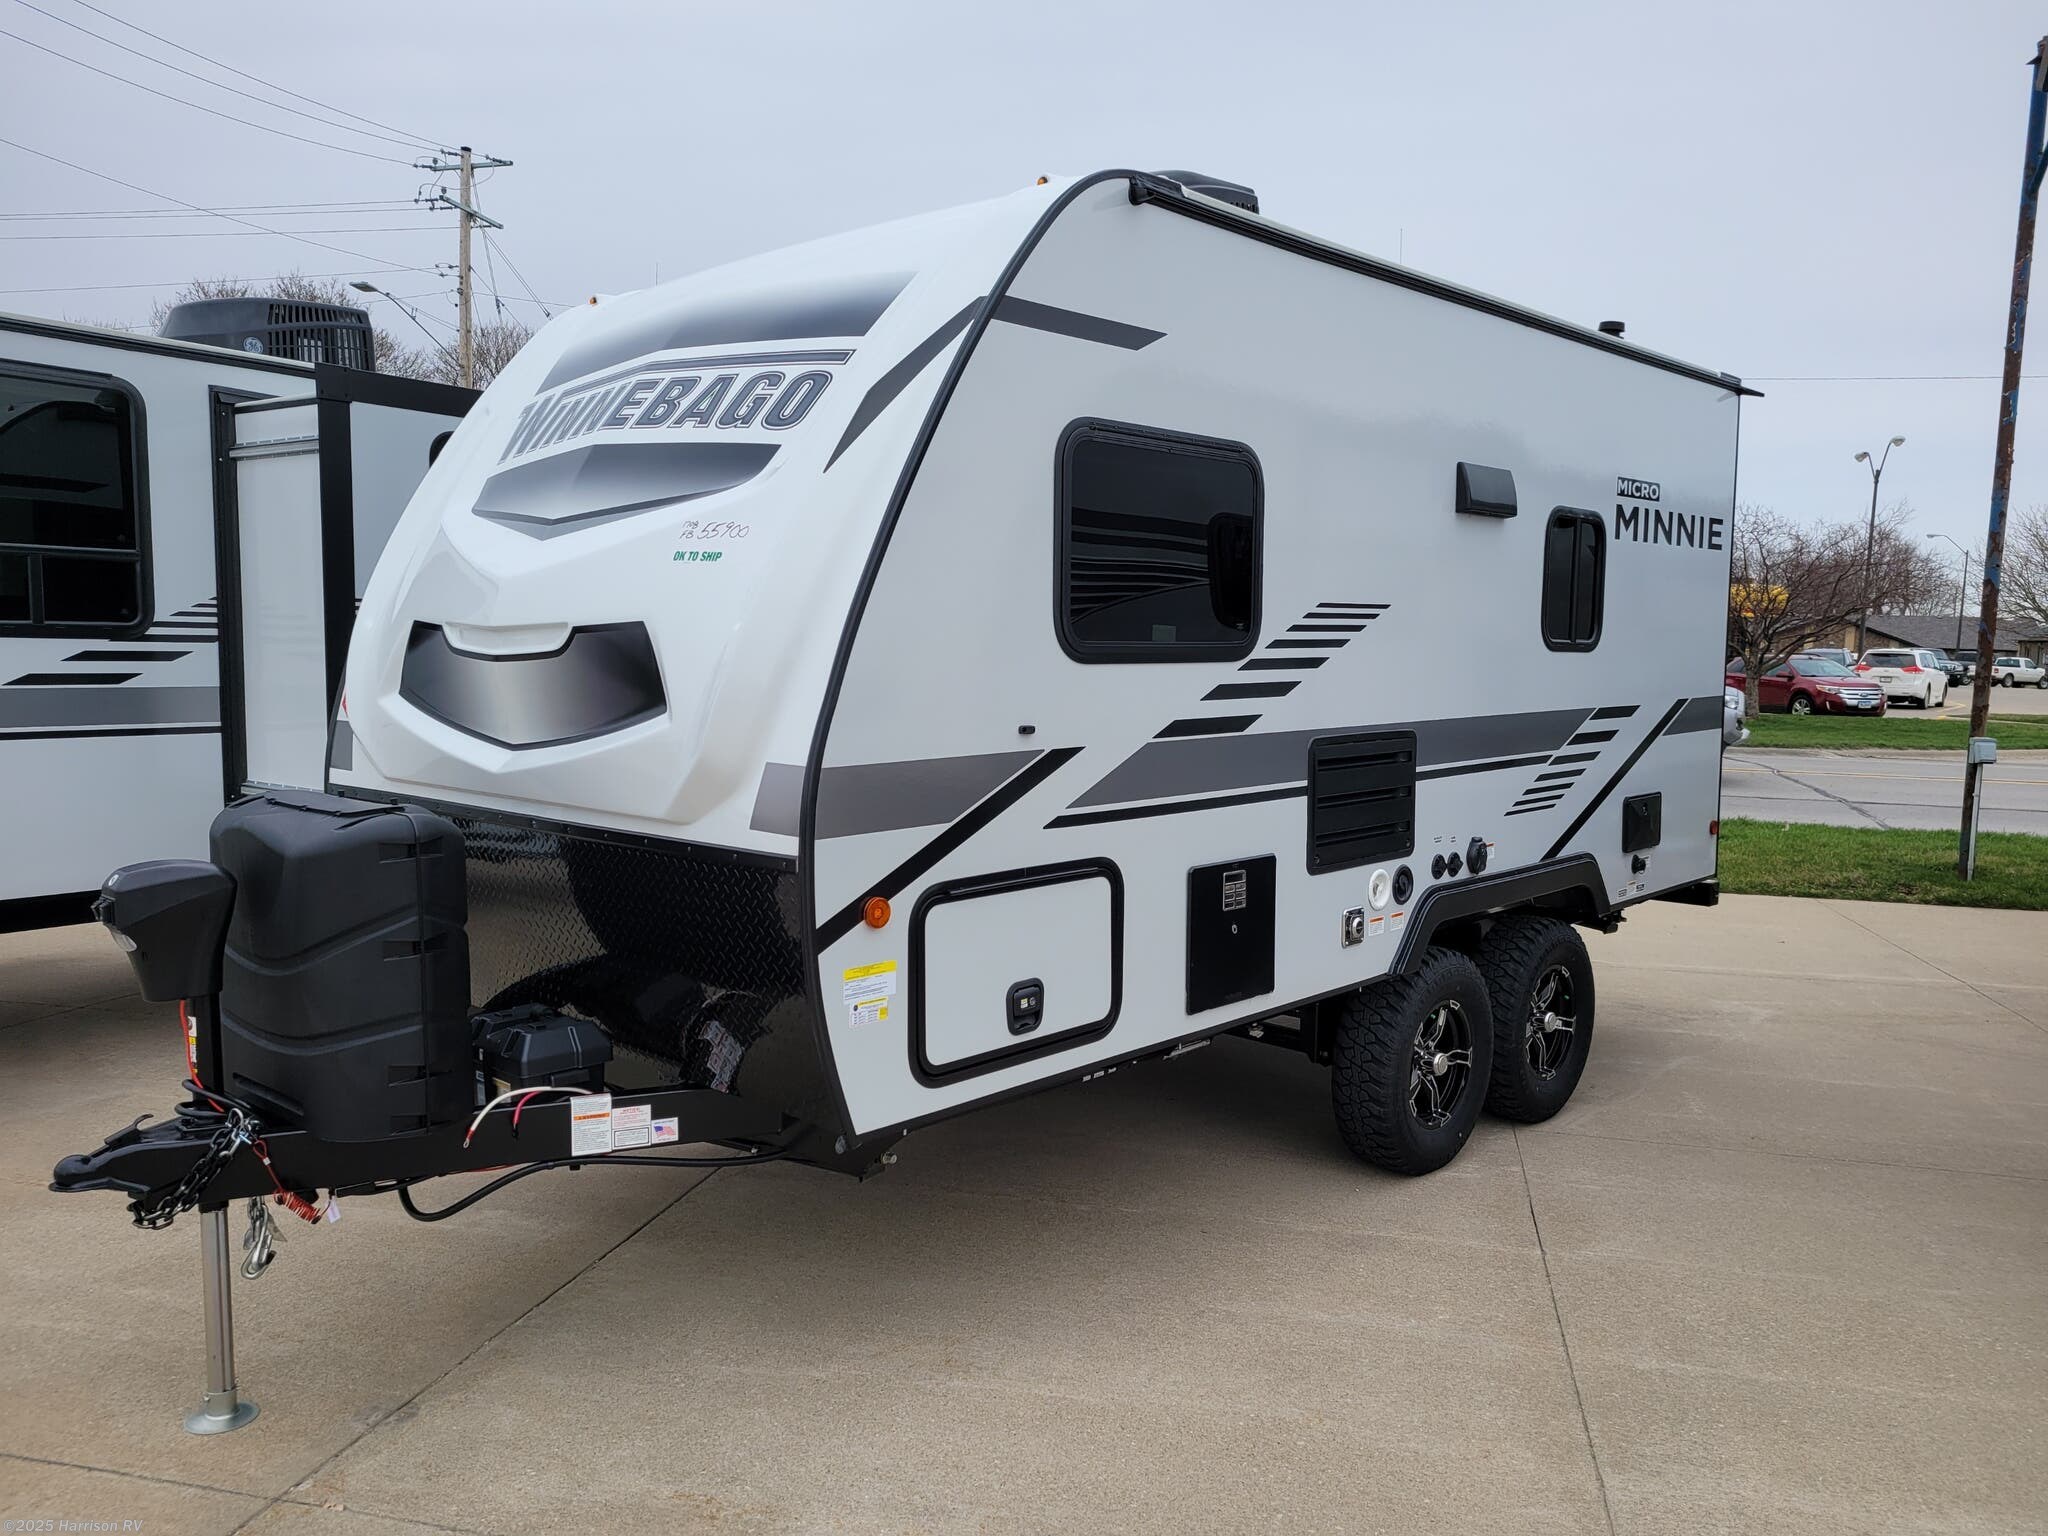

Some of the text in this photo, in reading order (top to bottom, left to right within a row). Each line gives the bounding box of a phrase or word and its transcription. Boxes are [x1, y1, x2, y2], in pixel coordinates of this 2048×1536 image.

[497, 369, 833, 466] WINNEBAGO
[1616, 478, 1660, 501] MICRO
[697, 521, 750, 540] 55900
[1614, 503, 1724, 551] MINNIE
[673, 551, 723, 562] OK TO SHIP
